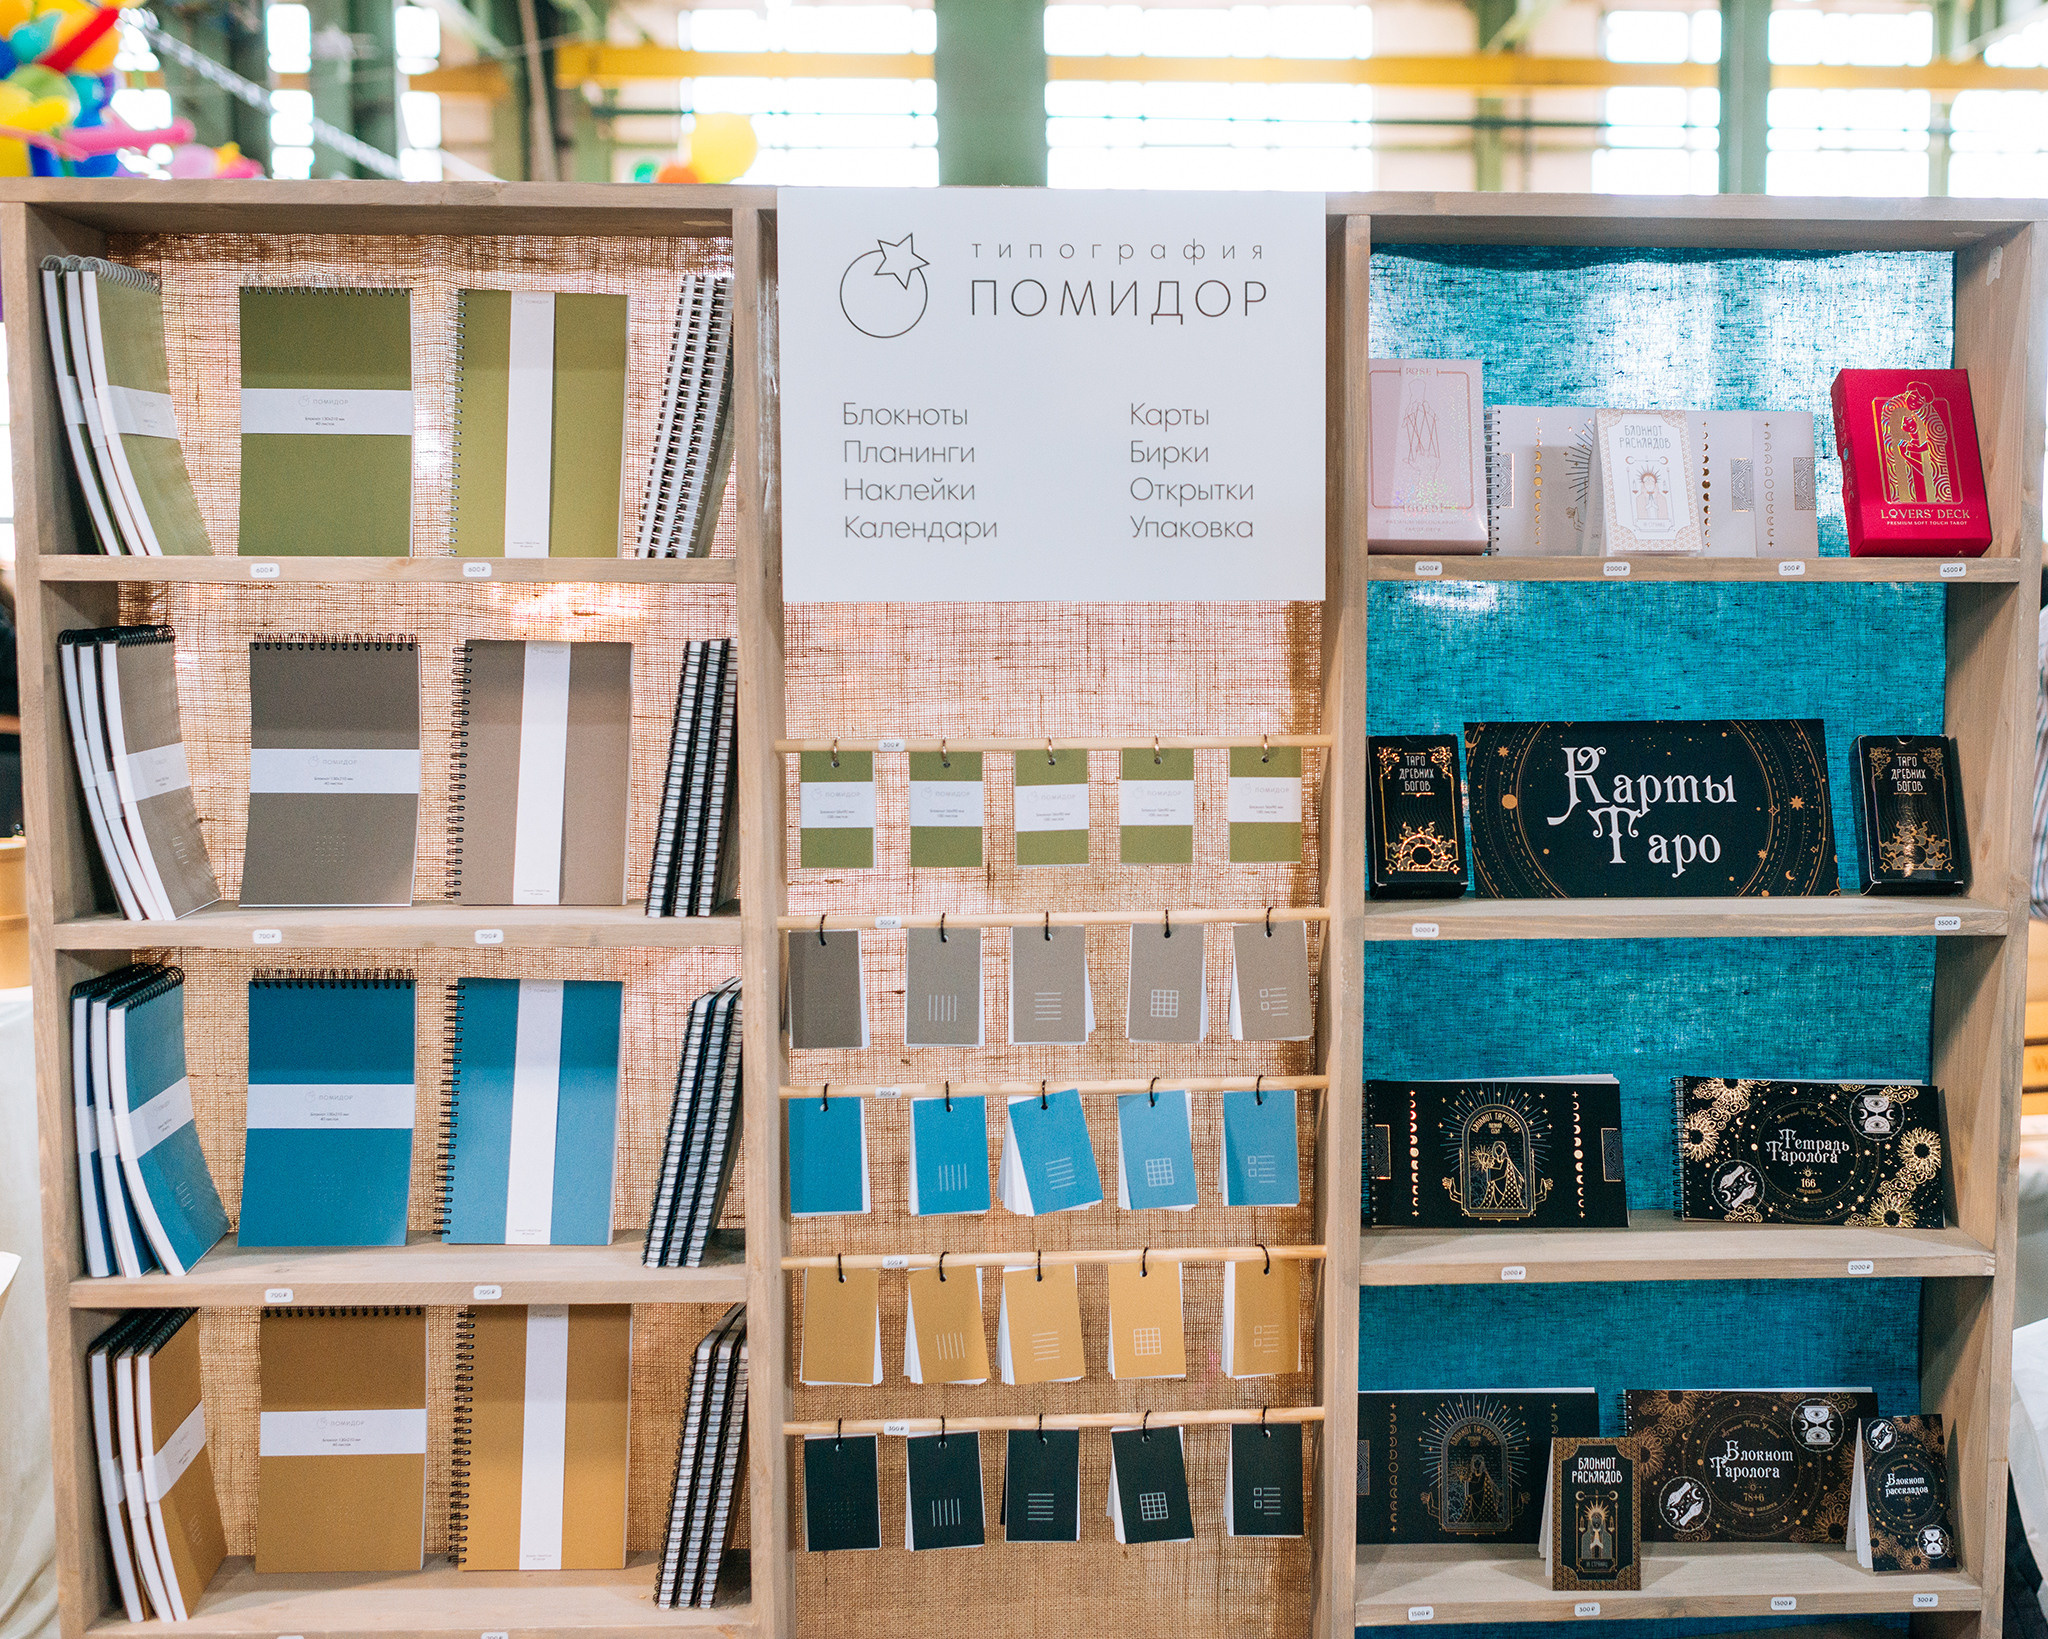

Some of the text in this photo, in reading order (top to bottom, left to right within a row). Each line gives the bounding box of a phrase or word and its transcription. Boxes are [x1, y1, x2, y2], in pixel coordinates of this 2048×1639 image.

[972, 238, 1264, 265] типография
[971, 279, 1267, 325] ПОМИДОР
[842, 402, 968, 426] Блокноты
[1130, 403, 1209, 432] Карты
[1624, 425, 1662, 436] БЛОКНОТ
[843, 441, 975, 464] Планинги
[1619, 438, 1671, 449] РАСКЛАДОВ
[1130, 441, 1209, 469] Бирки
[844, 477, 976, 501] Наклейки
[1129, 478, 1254, 507] Открытки
[1937, 509, 1970, 519] DECK
[844, 516, 998, 545] Календари
[1130, 516, 1254, 539] Упаковка
[1406, 756, 1426, 766] ТАРО
[1897, 756, 1917, 767] ТАРО
[1399, 768, 1434, 779] ДРЕВНИХ
[1891, 769, 1927, 780] ДРЕВНИХ
[1404, 781, 1431, 792] БОГОВ
[1547, 746, 1737, 825] Карты
[1897, 781, 1923, 792] БОГОВ
[1587, 804, 1721, 878] Таро
[1779, 1128, 1850, 1154] Тетрадь
[1765, 1140, 1839, 1166] Таролога
[1801, 1178, 1816, 1188] 166
[1721, 1440, 1793, 1462] Блокнот
[1578, 1457, 1616, 1470] БЛОКНОТ
[1709, 1456, 1780, 1482] Таролога
[1571, 1470, 1623, 1485] РАСКЛАДОВ
[1885, 1473, 1925, 1488] Блокнот
[1743, 1493, 1764, 1502] 78+6
